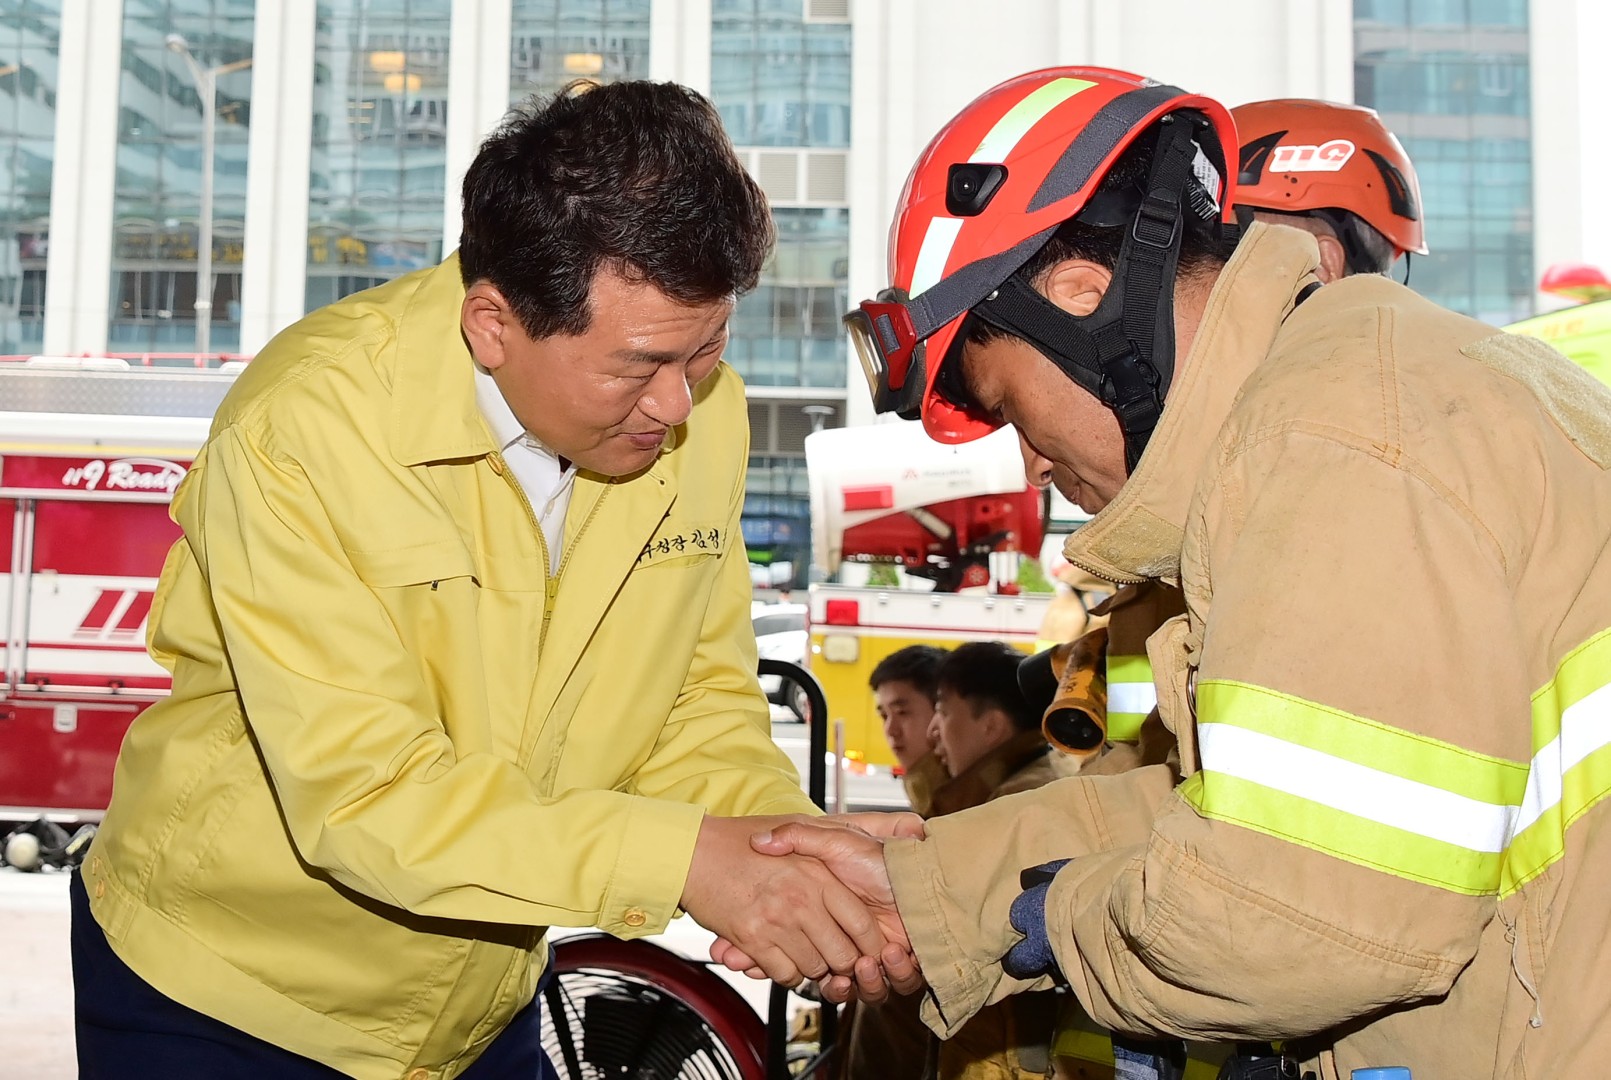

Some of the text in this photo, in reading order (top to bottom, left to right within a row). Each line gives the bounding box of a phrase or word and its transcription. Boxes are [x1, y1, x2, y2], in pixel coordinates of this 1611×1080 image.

[1270, 139, 1355, 172] 119
[62, 459, 186, 493] 119 Ready
